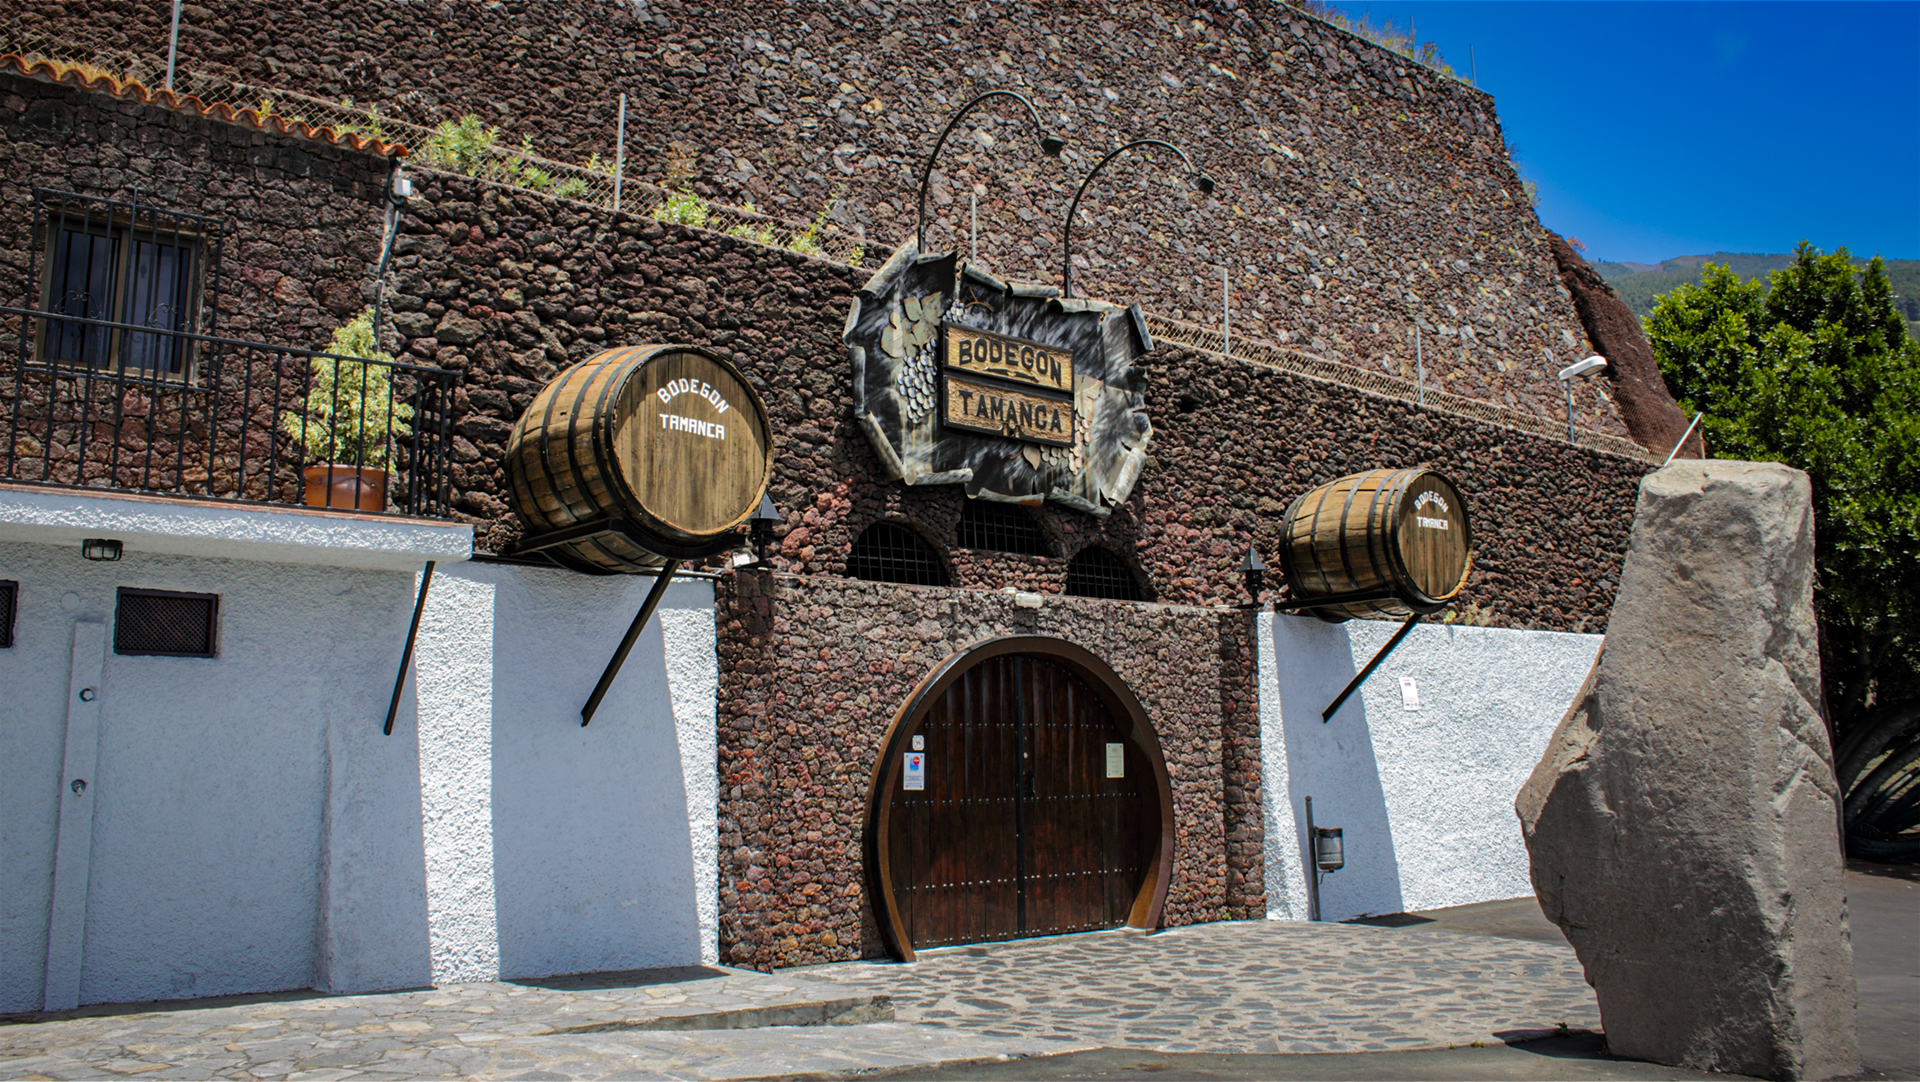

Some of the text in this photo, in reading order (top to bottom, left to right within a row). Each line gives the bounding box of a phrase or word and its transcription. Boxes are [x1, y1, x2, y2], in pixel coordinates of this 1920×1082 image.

[959, 338, 1062, 387] BODEGON
[657, 378, 729, 414] BODEGON
[958, 389, 1062, 433] TAMANCA
[659, 413, 726, 440] TAMANCA
[1414, 490, 1449, 513] BODEGON
